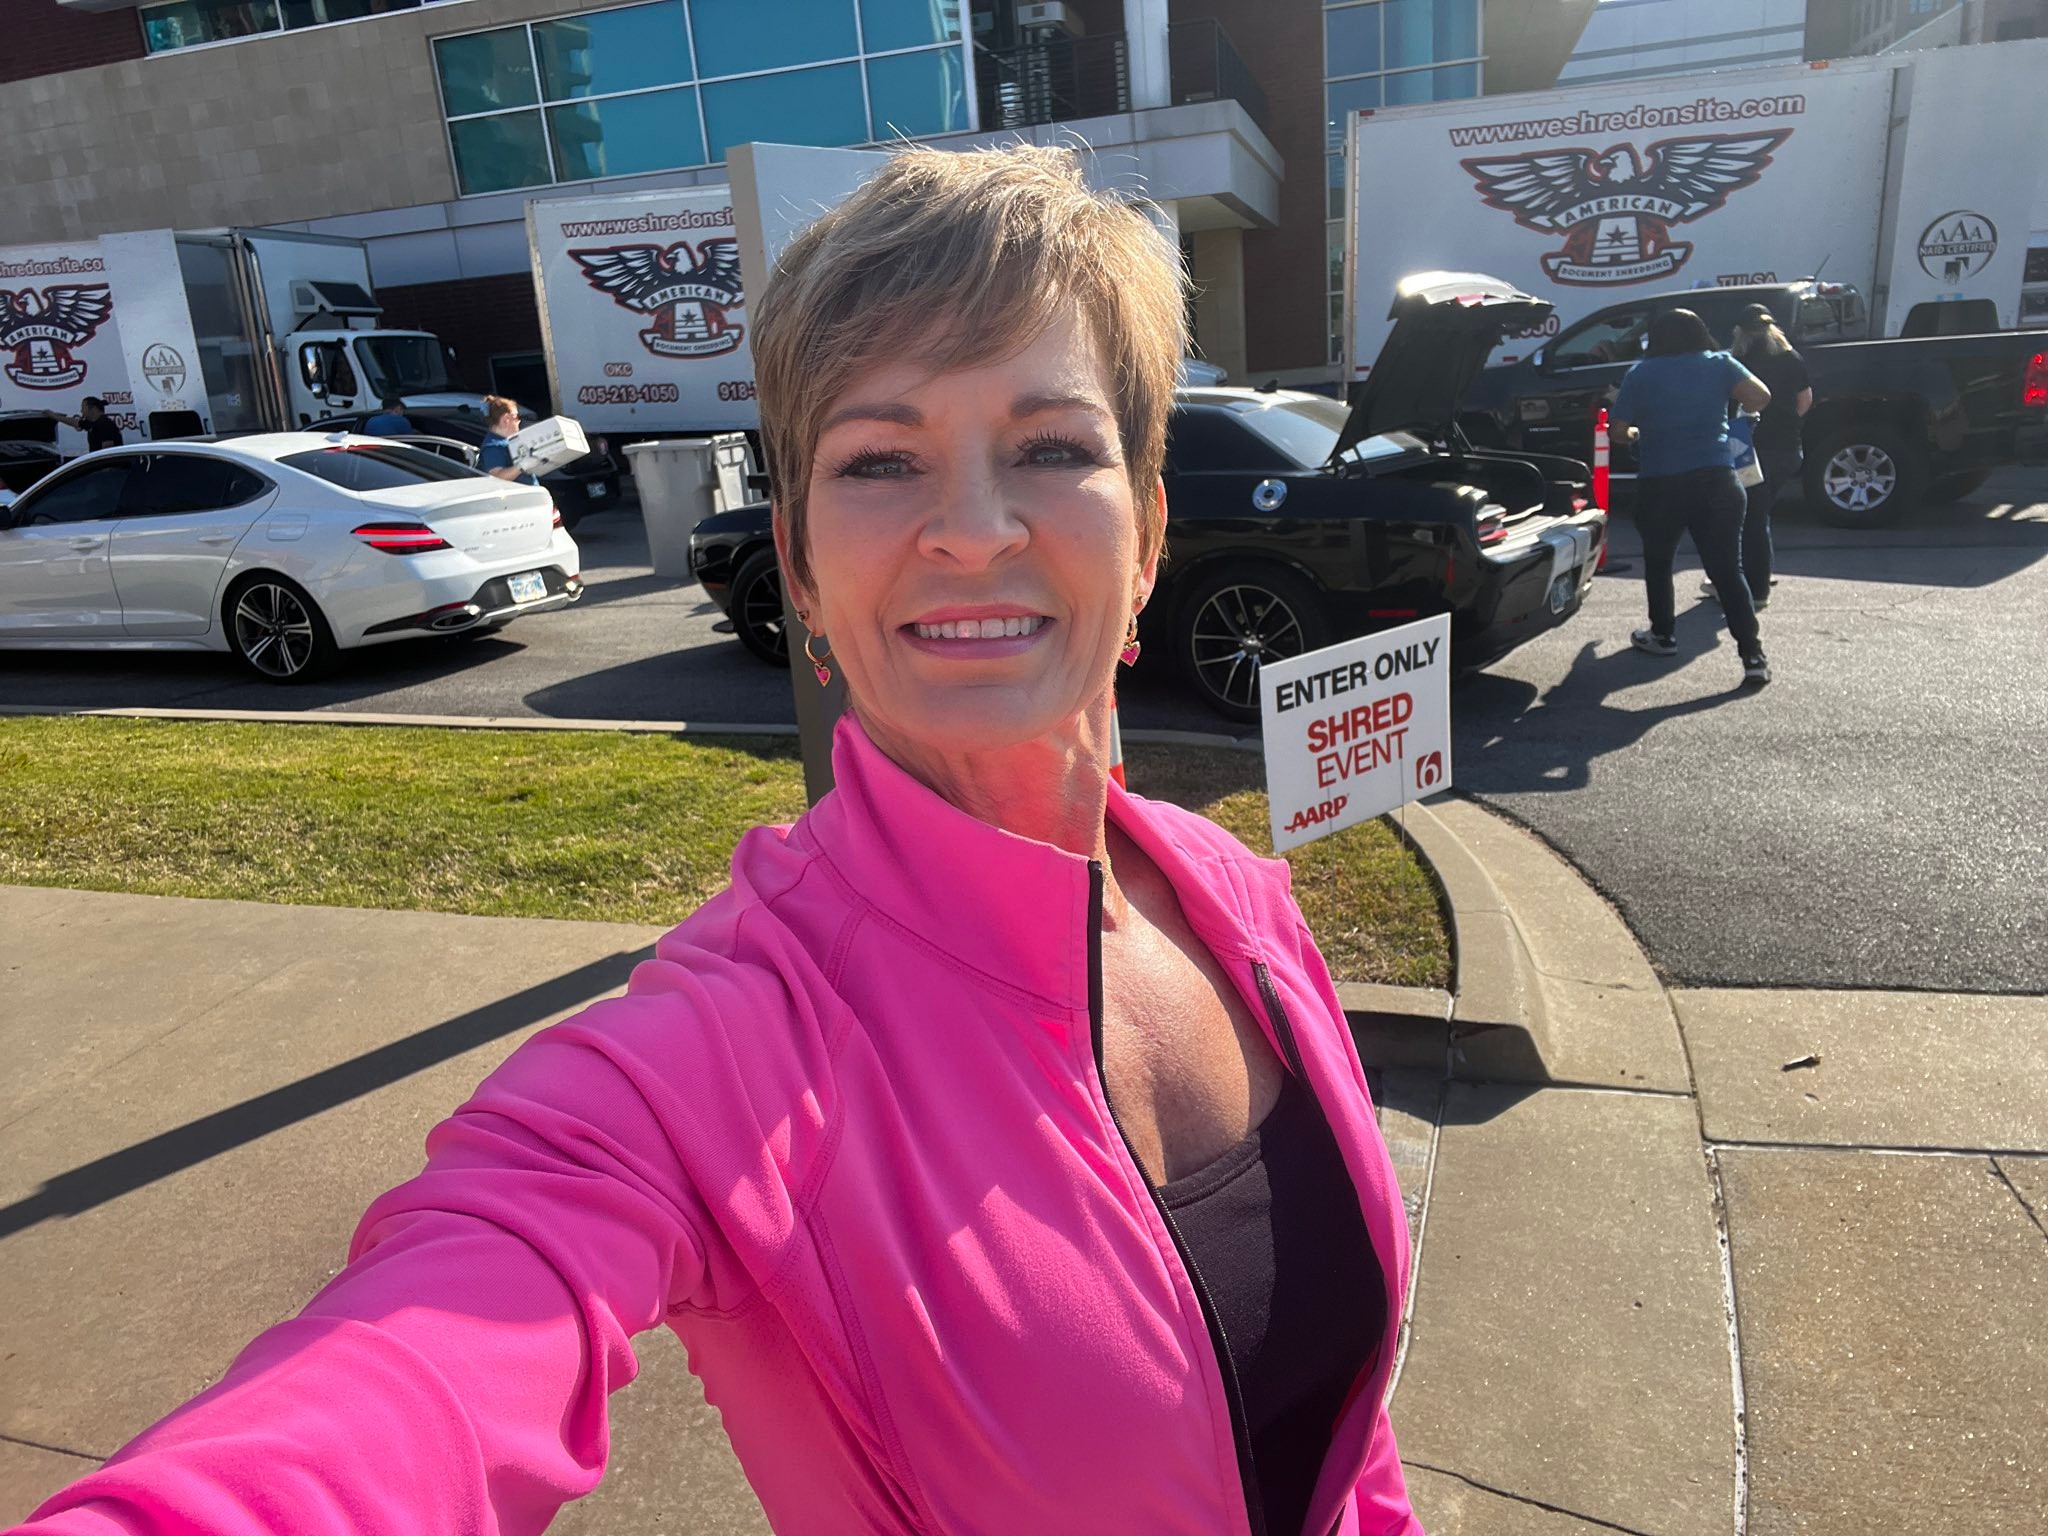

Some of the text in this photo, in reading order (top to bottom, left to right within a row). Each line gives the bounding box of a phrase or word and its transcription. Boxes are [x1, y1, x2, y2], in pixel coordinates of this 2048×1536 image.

[1450, 95, 1805, 147] www.weshredonsite.com
[1565, 197, 1673, 223] AMERICAN
[1561, 260, 1670, 278] DOCUMENT SHREDDING
[650, 286, 725, 306] AMERICAN
[9, 326, 69, 344] AMERICAN
[604, 362, 633, 377] OKC
[578, 384, 680, 404] 405-213-1050
[717, 381, 757, 402] 918-
[1276, 637, 1440, 713] ENTER ONLY
[1307, 692, 1414, 753] SHRED
[1317, 727, 1409, 789] EVENT
[1416, 751, 1442, 789] 6
[1284, 794, 1348, 833] AARP
